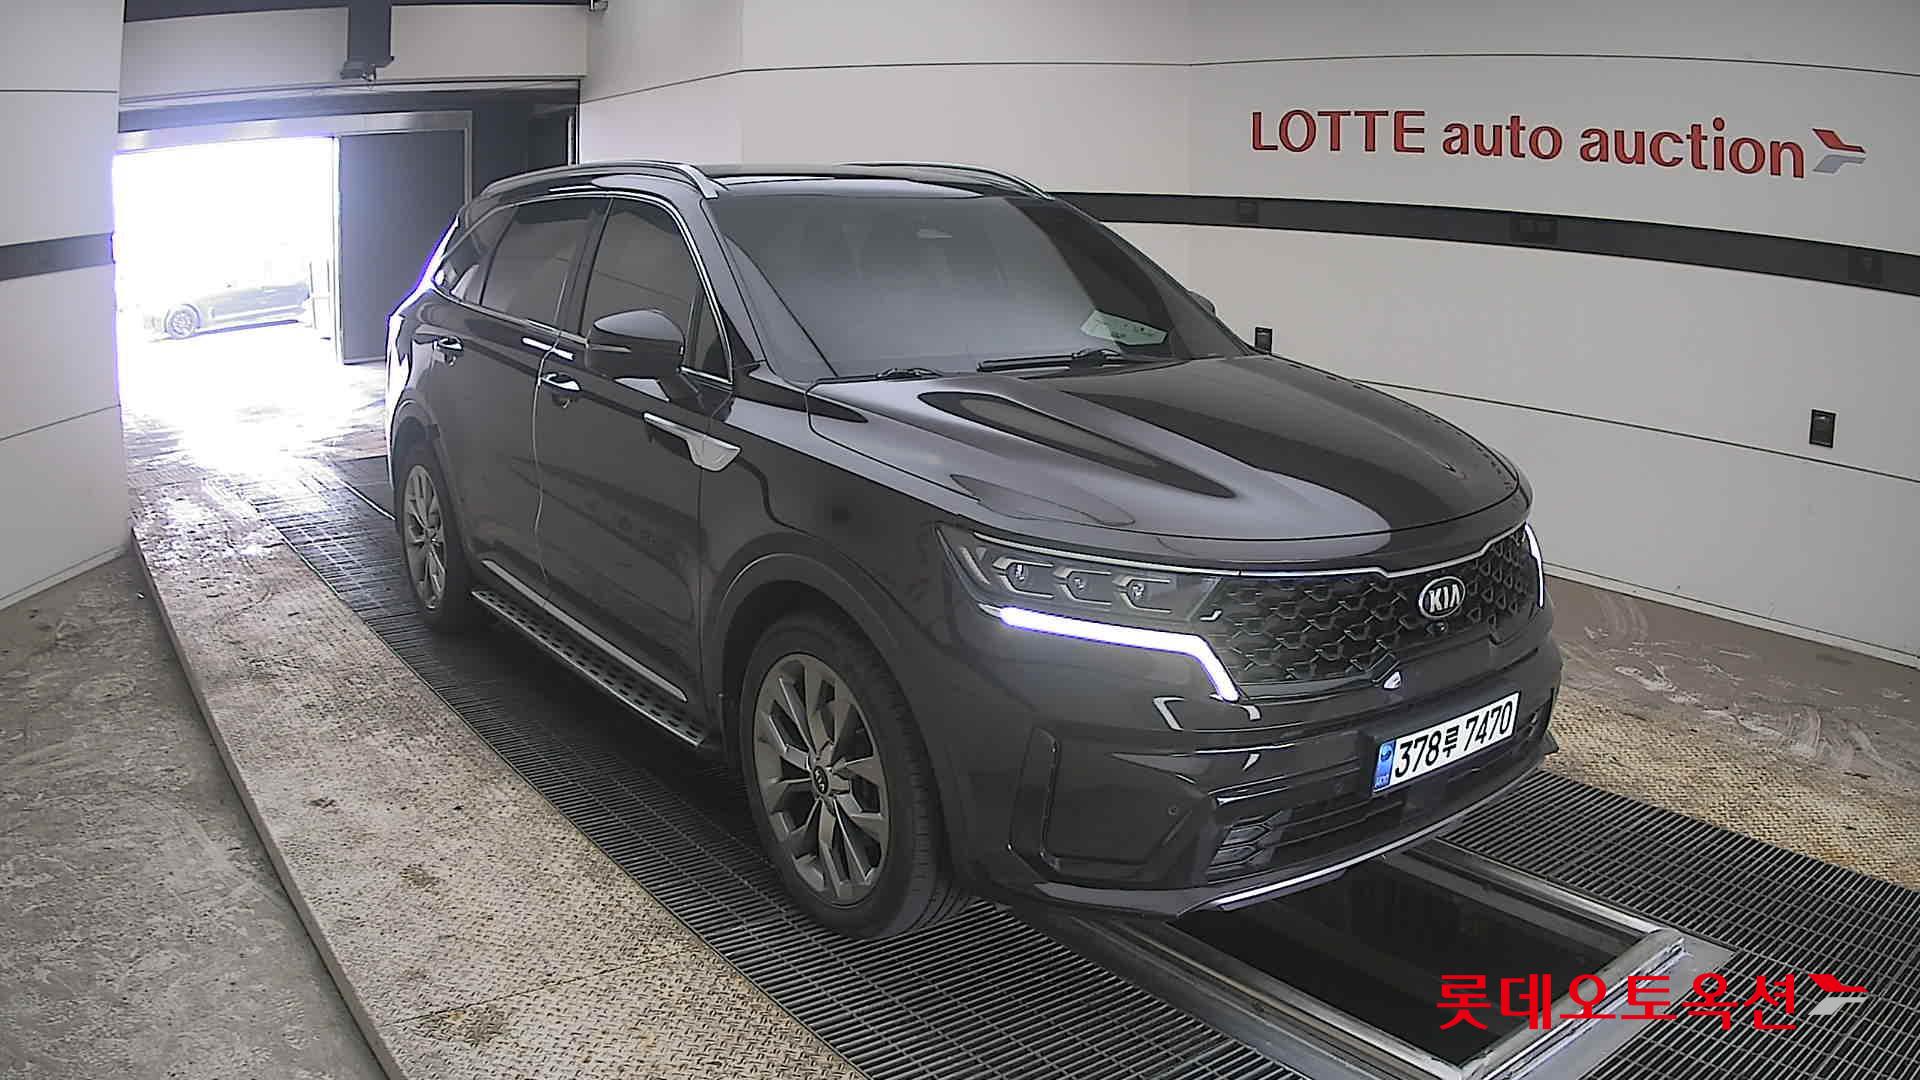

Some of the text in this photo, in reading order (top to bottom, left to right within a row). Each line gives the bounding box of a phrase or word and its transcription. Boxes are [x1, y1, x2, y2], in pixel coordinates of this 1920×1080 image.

[1252, 110, 1806, 179] LOTTE auto auction
[1428, 584, 1461, 613] KIA
[1395, 701, 1513, 779] 378루 7470
